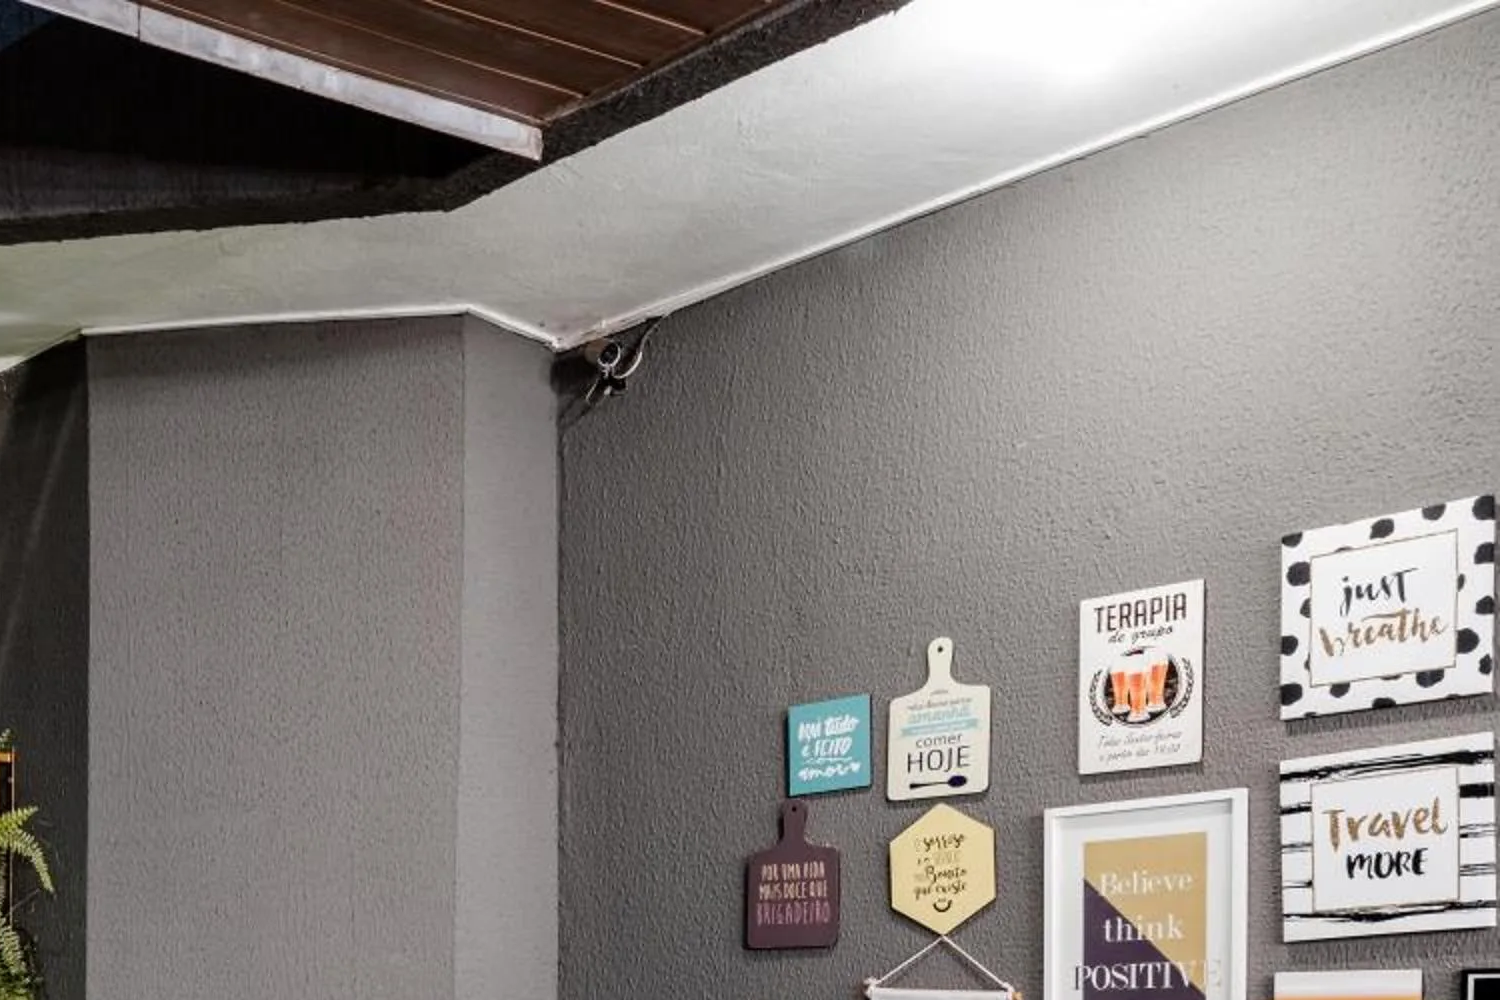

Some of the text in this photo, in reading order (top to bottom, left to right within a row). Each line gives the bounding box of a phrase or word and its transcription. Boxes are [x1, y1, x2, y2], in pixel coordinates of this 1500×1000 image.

[1093, 593, 1187, 633] TERAPIA
[1108, 624, 1174, 645] de grupo
[1319, 608, 1447, 657] breathe
[916, 733, 963, 749] comer
[907, 745, 971, 774] HOJE
[1322, 796, 1447, 851] Travel
[1346, 848, 1428, 879] MORE
[1101, 868, 1193, 897] Believe
[757, 899, 832, 926] BRIGADEIRO
[1103, 912, 1185, 944] think
